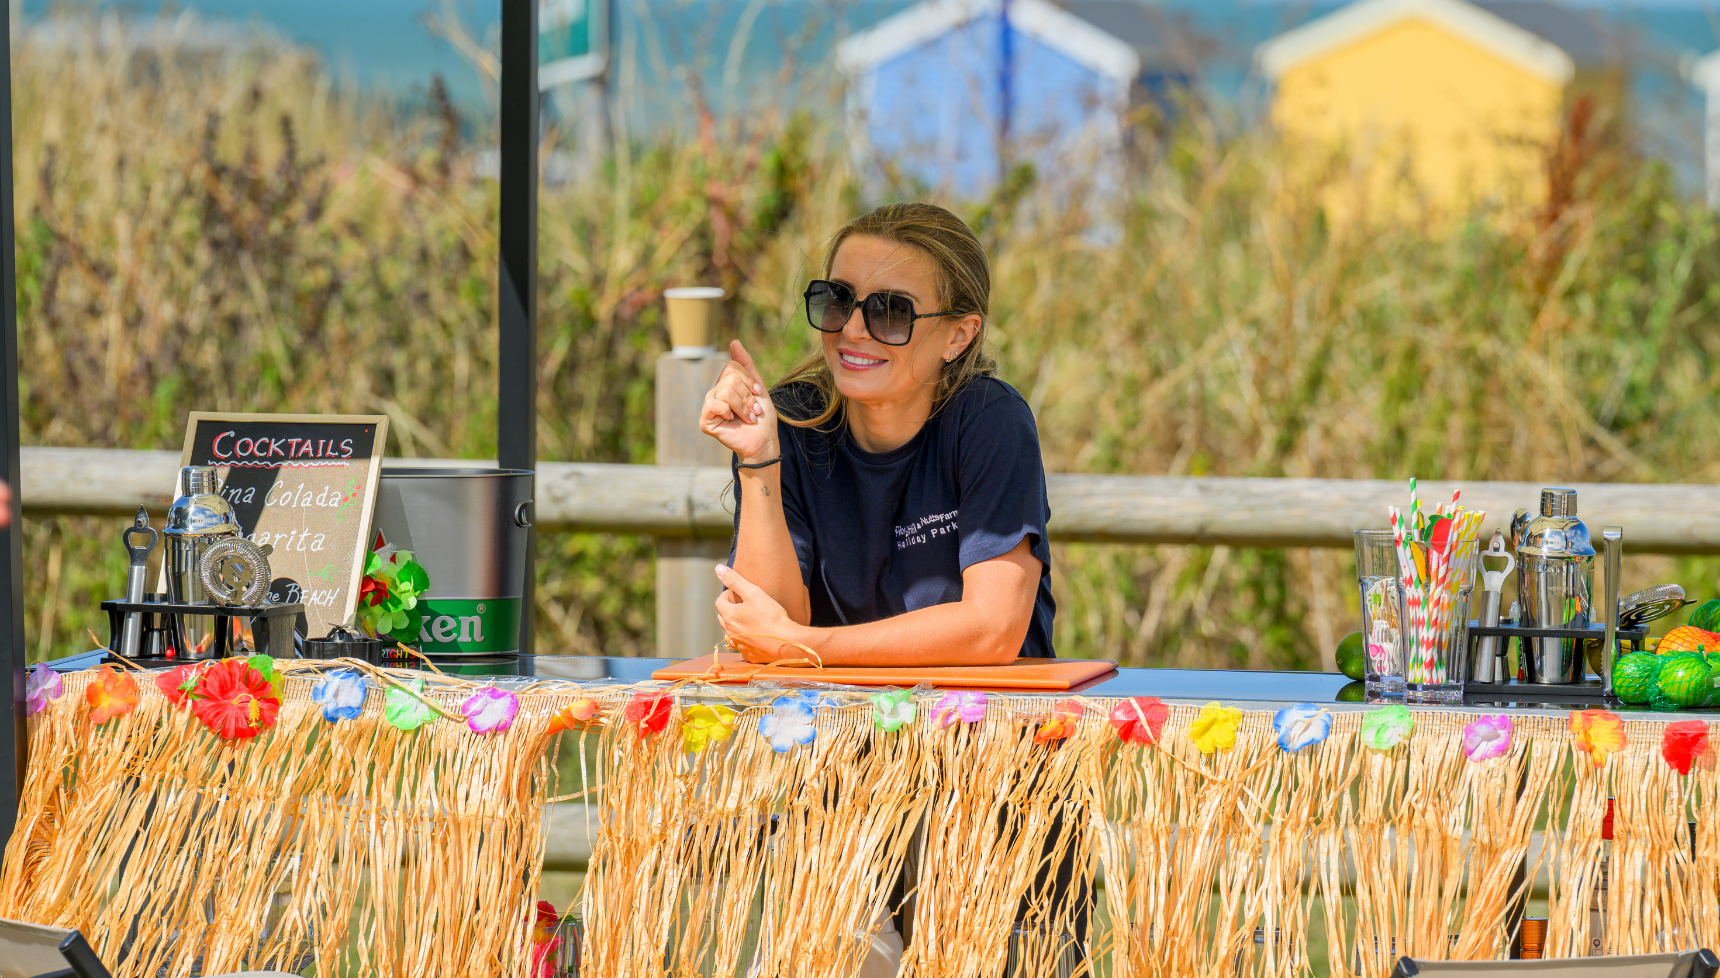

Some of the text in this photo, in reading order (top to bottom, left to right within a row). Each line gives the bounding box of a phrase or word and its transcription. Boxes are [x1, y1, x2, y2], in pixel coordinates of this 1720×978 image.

[212, 430, 354, 460] COCKTAILS
[264, 479, 342, 508] Colada
[897, 534, 926, 550] Holiday
[931, 522, 958, 538] Park
[285, 582, 341, 607] BEACH
[413, 614, 486, 643] ken
